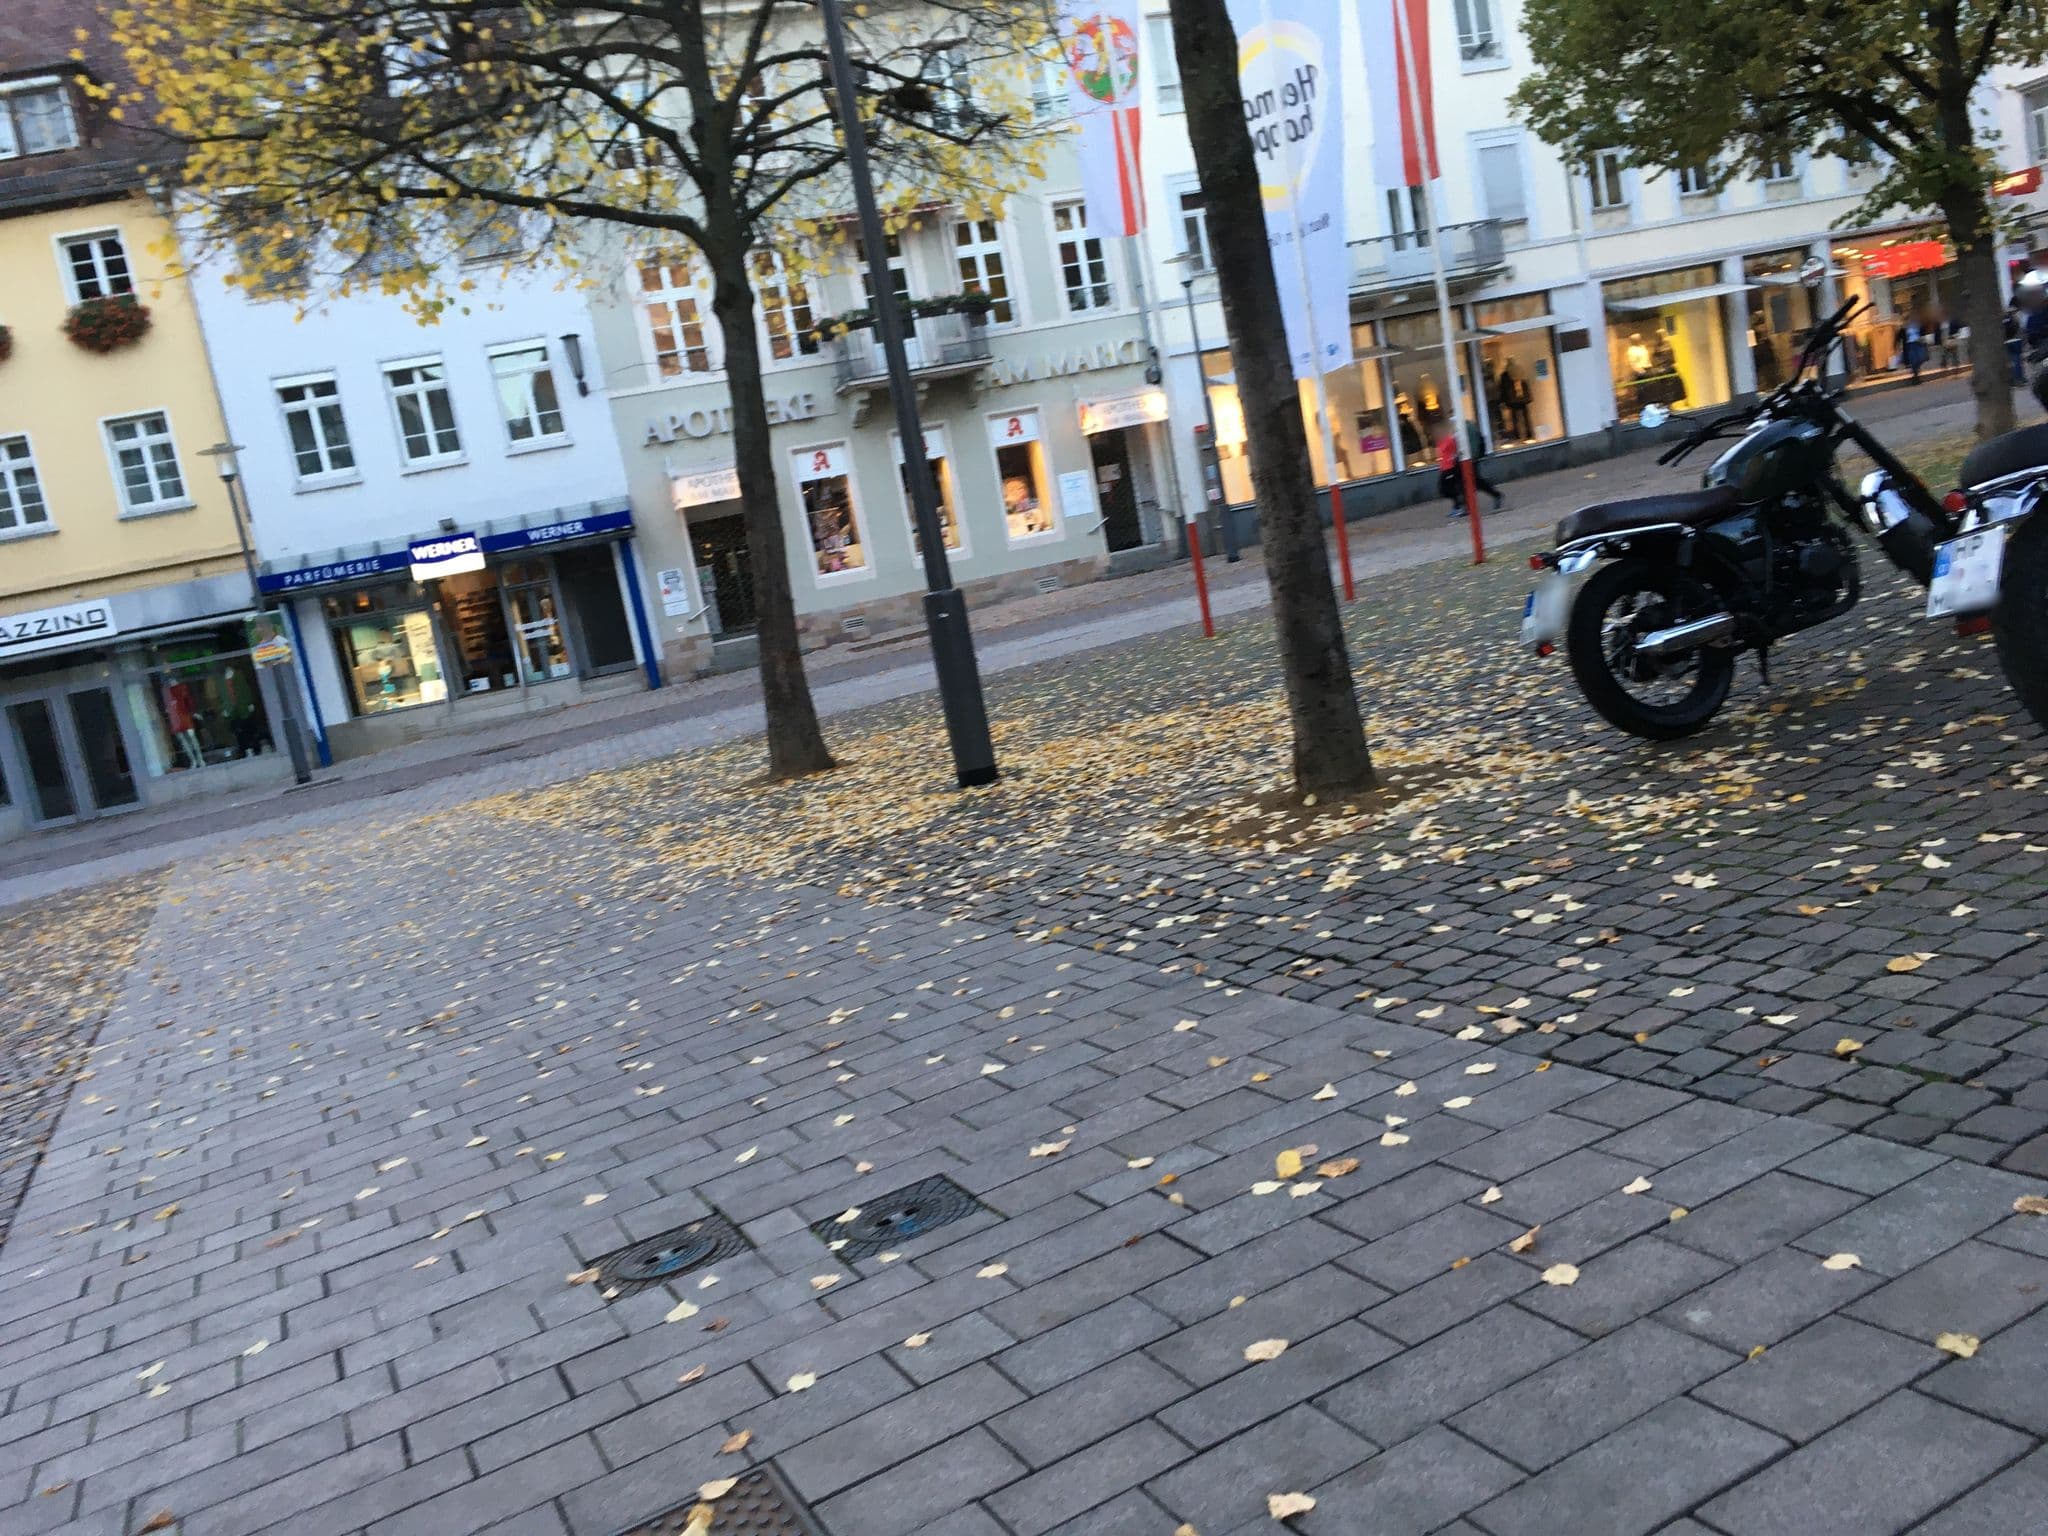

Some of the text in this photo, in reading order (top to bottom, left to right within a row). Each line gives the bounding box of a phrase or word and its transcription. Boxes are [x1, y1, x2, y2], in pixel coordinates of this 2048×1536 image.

[645, 391, 816, 446] APOTEKE
[527, 521, 585, 541] WERNER
[411, 537, 477, 561] WERNER
